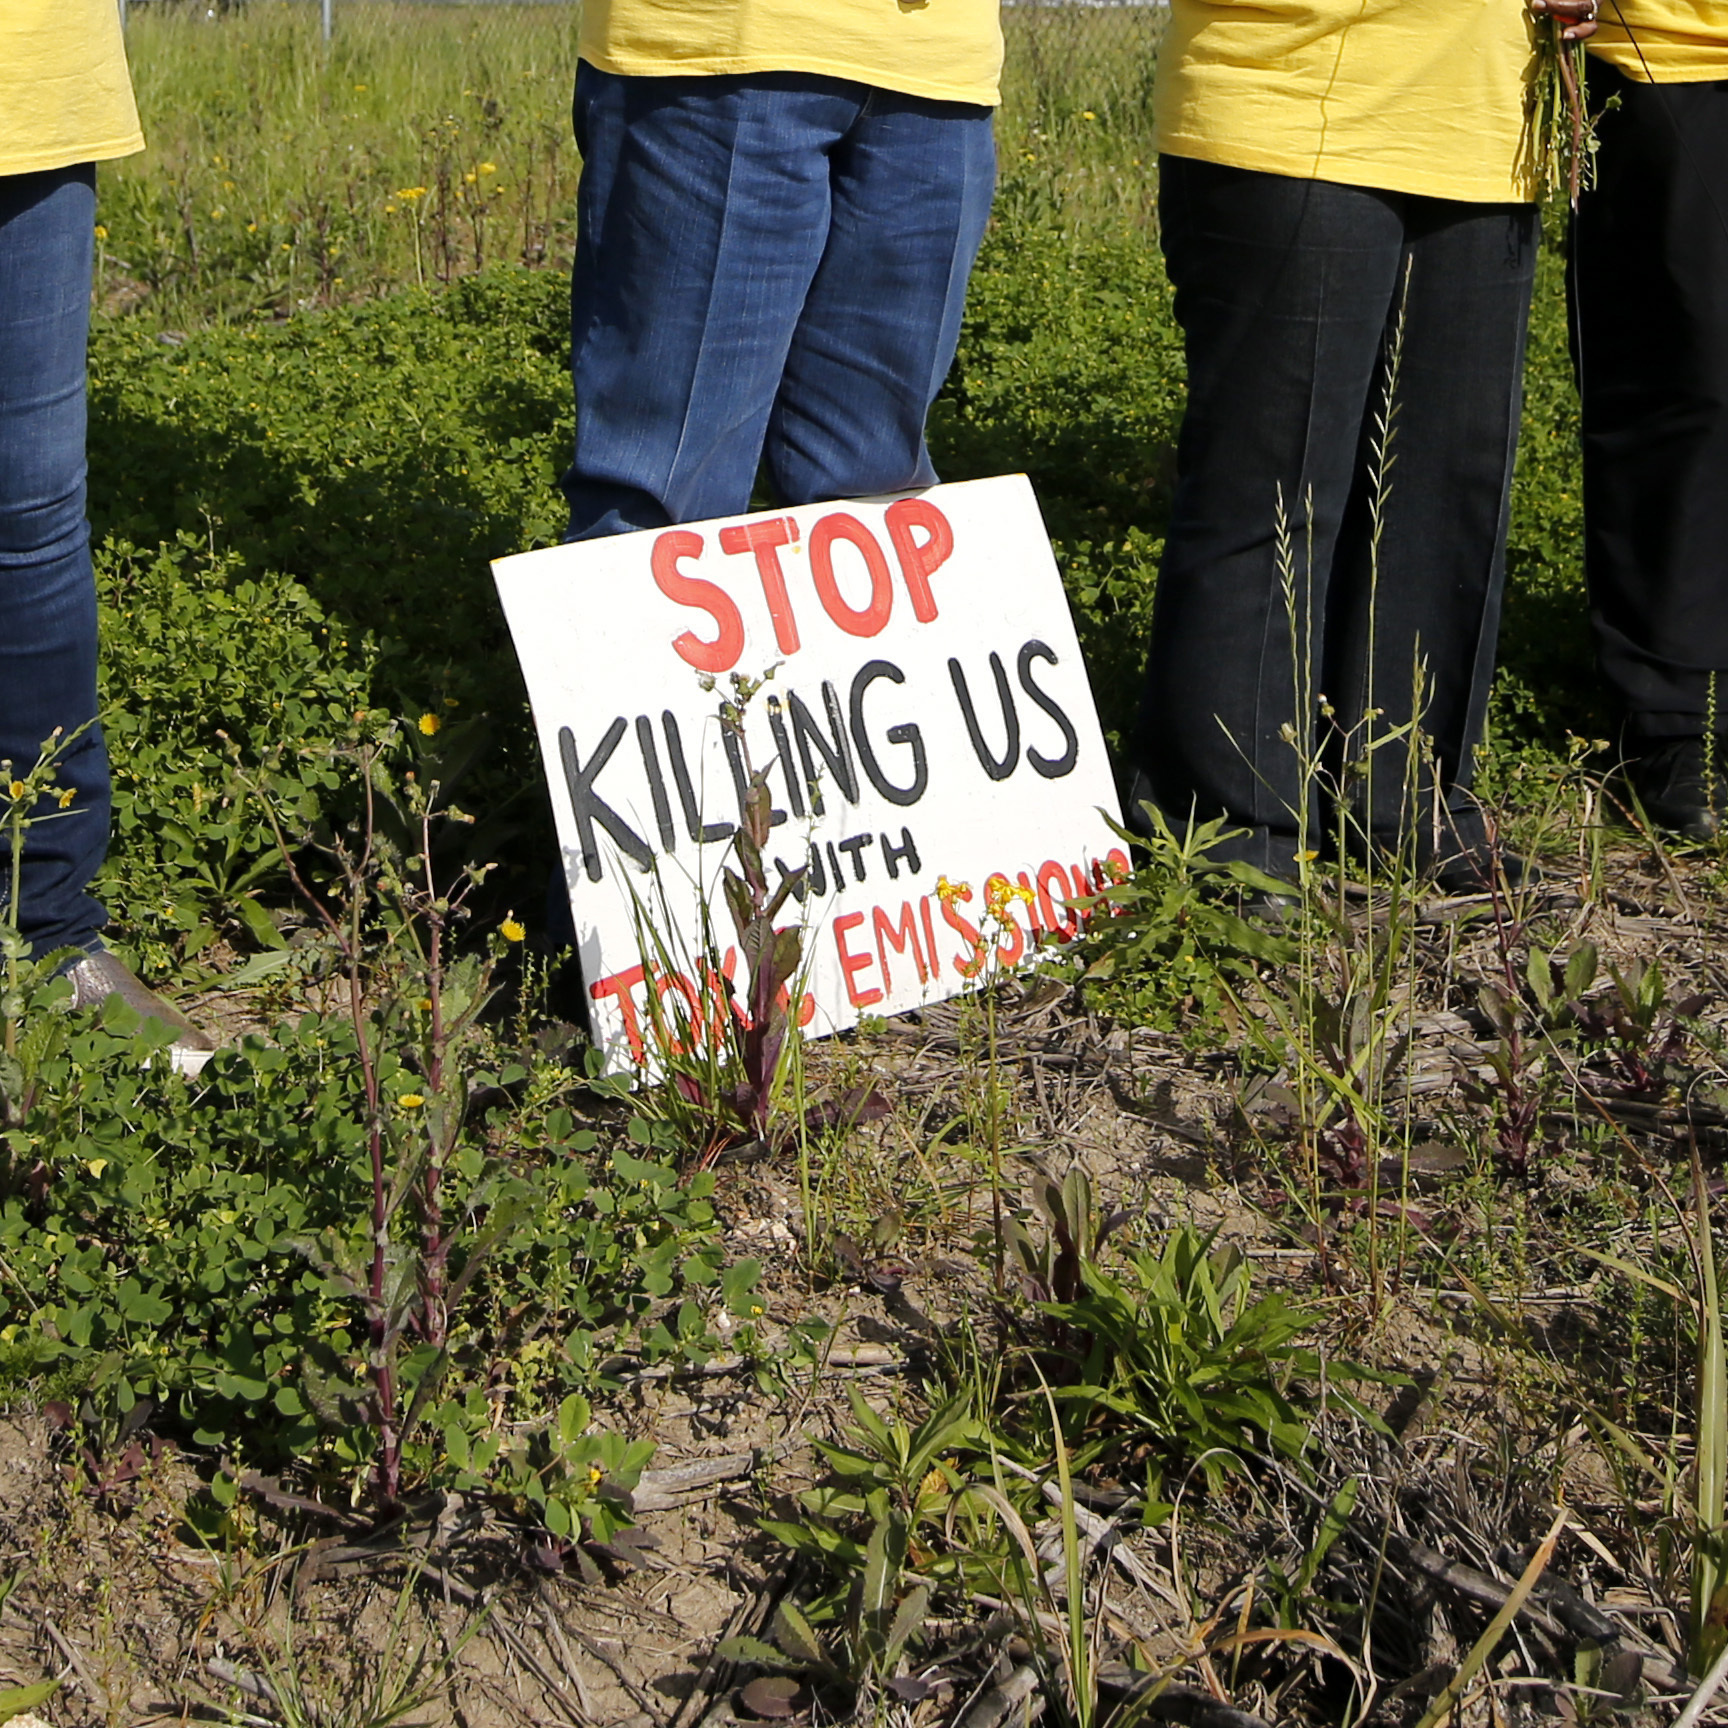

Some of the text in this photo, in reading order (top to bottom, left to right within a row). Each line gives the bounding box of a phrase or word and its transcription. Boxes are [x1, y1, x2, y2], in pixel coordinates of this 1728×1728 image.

[650, 497, 954, 674] STOP
[558, 638, 1080, 883] KILLING US
[774, 825, 922, 904] WITH
[589, 925, 816, 1065] TOX
